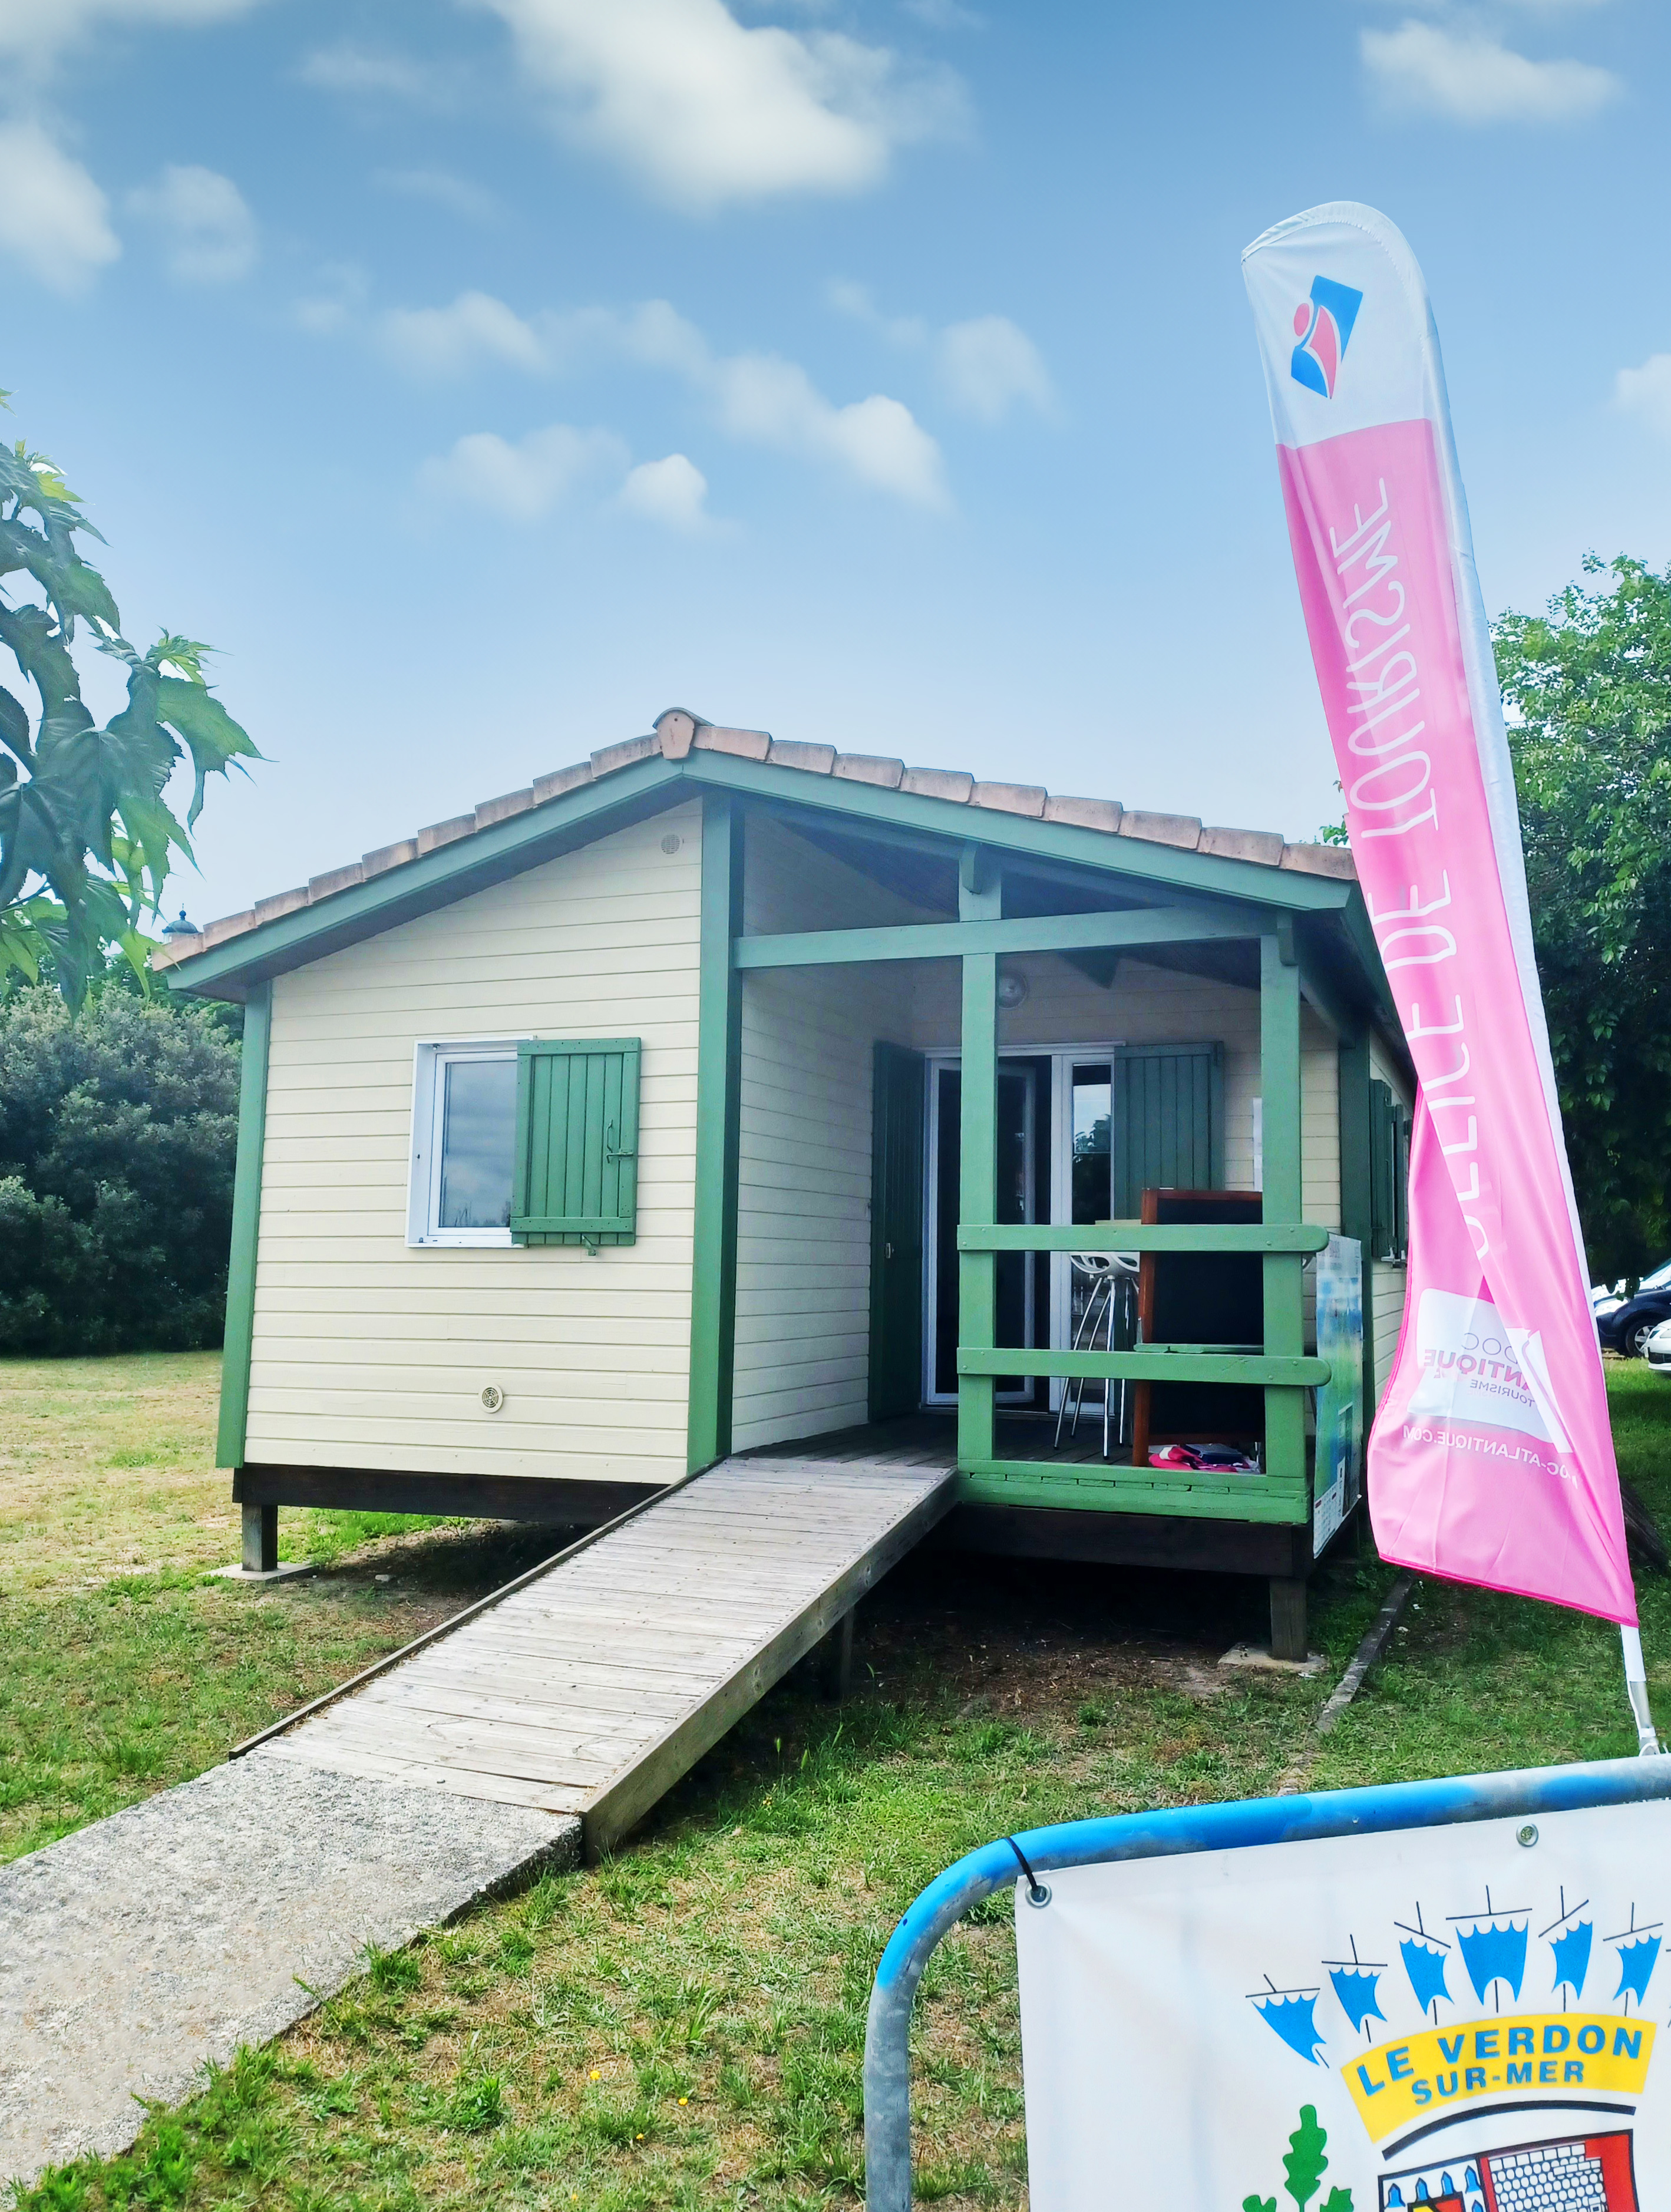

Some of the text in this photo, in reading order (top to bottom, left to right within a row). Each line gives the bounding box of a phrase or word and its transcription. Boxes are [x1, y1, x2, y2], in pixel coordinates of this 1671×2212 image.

[1356, 2025, 1643, 2097] LE VERDON
[1411, 2061, 1585, 2105] SUR-MER
